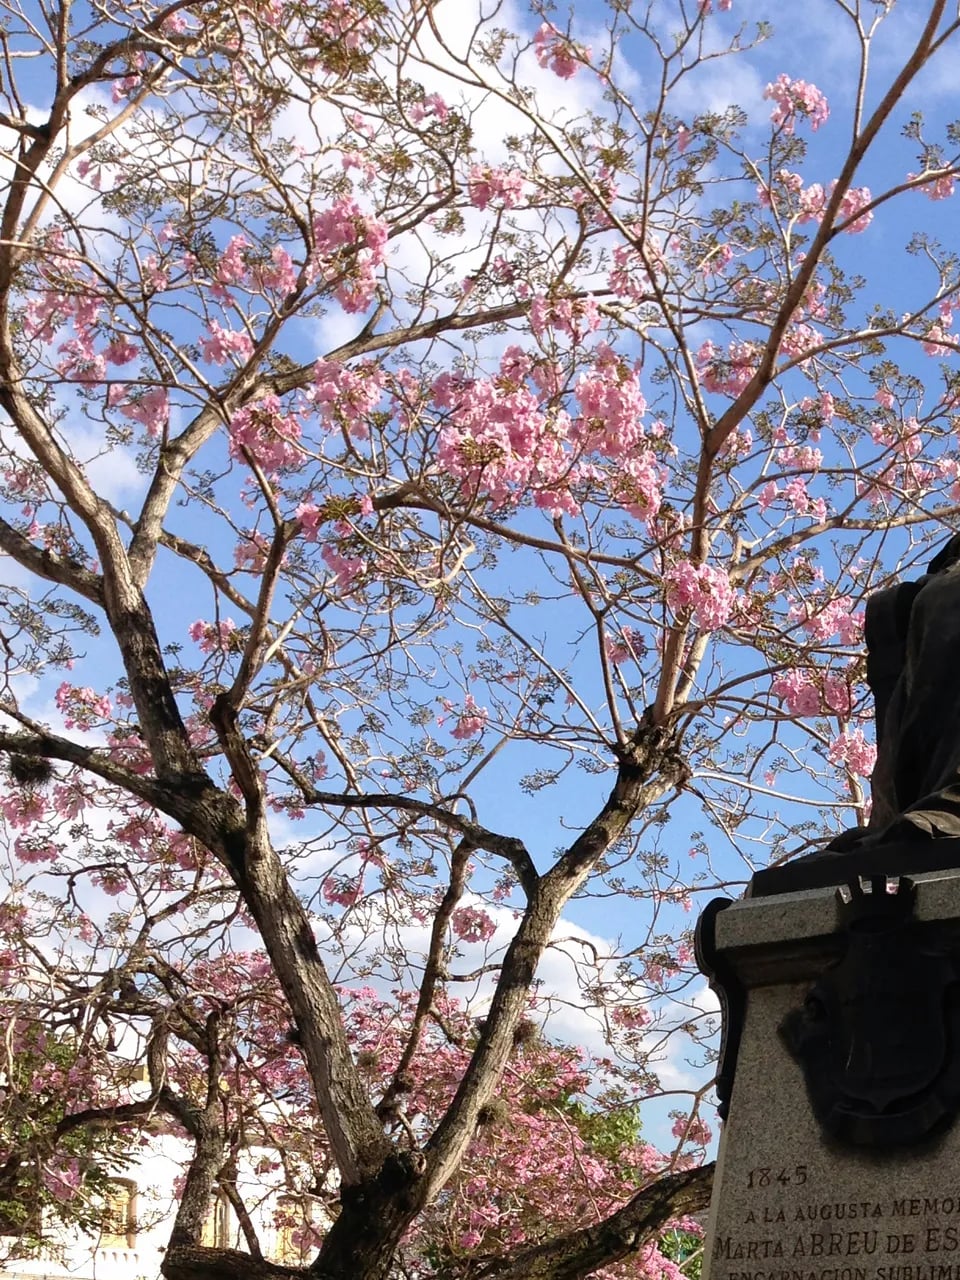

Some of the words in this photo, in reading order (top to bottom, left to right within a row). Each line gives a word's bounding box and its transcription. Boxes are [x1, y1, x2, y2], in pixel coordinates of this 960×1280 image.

[746, 1165, 808, 1189] 1845
[743, 1209, 757, 1224] A
[763, 1206, 787, 1223] LA
[794, 1201, 884, 1223] AUGUSTA
[713, 1235, 784, 1261] MARTA
[791, 1229, 879, 1257] ABREU
[885, 1233, 915, 1254] DE
